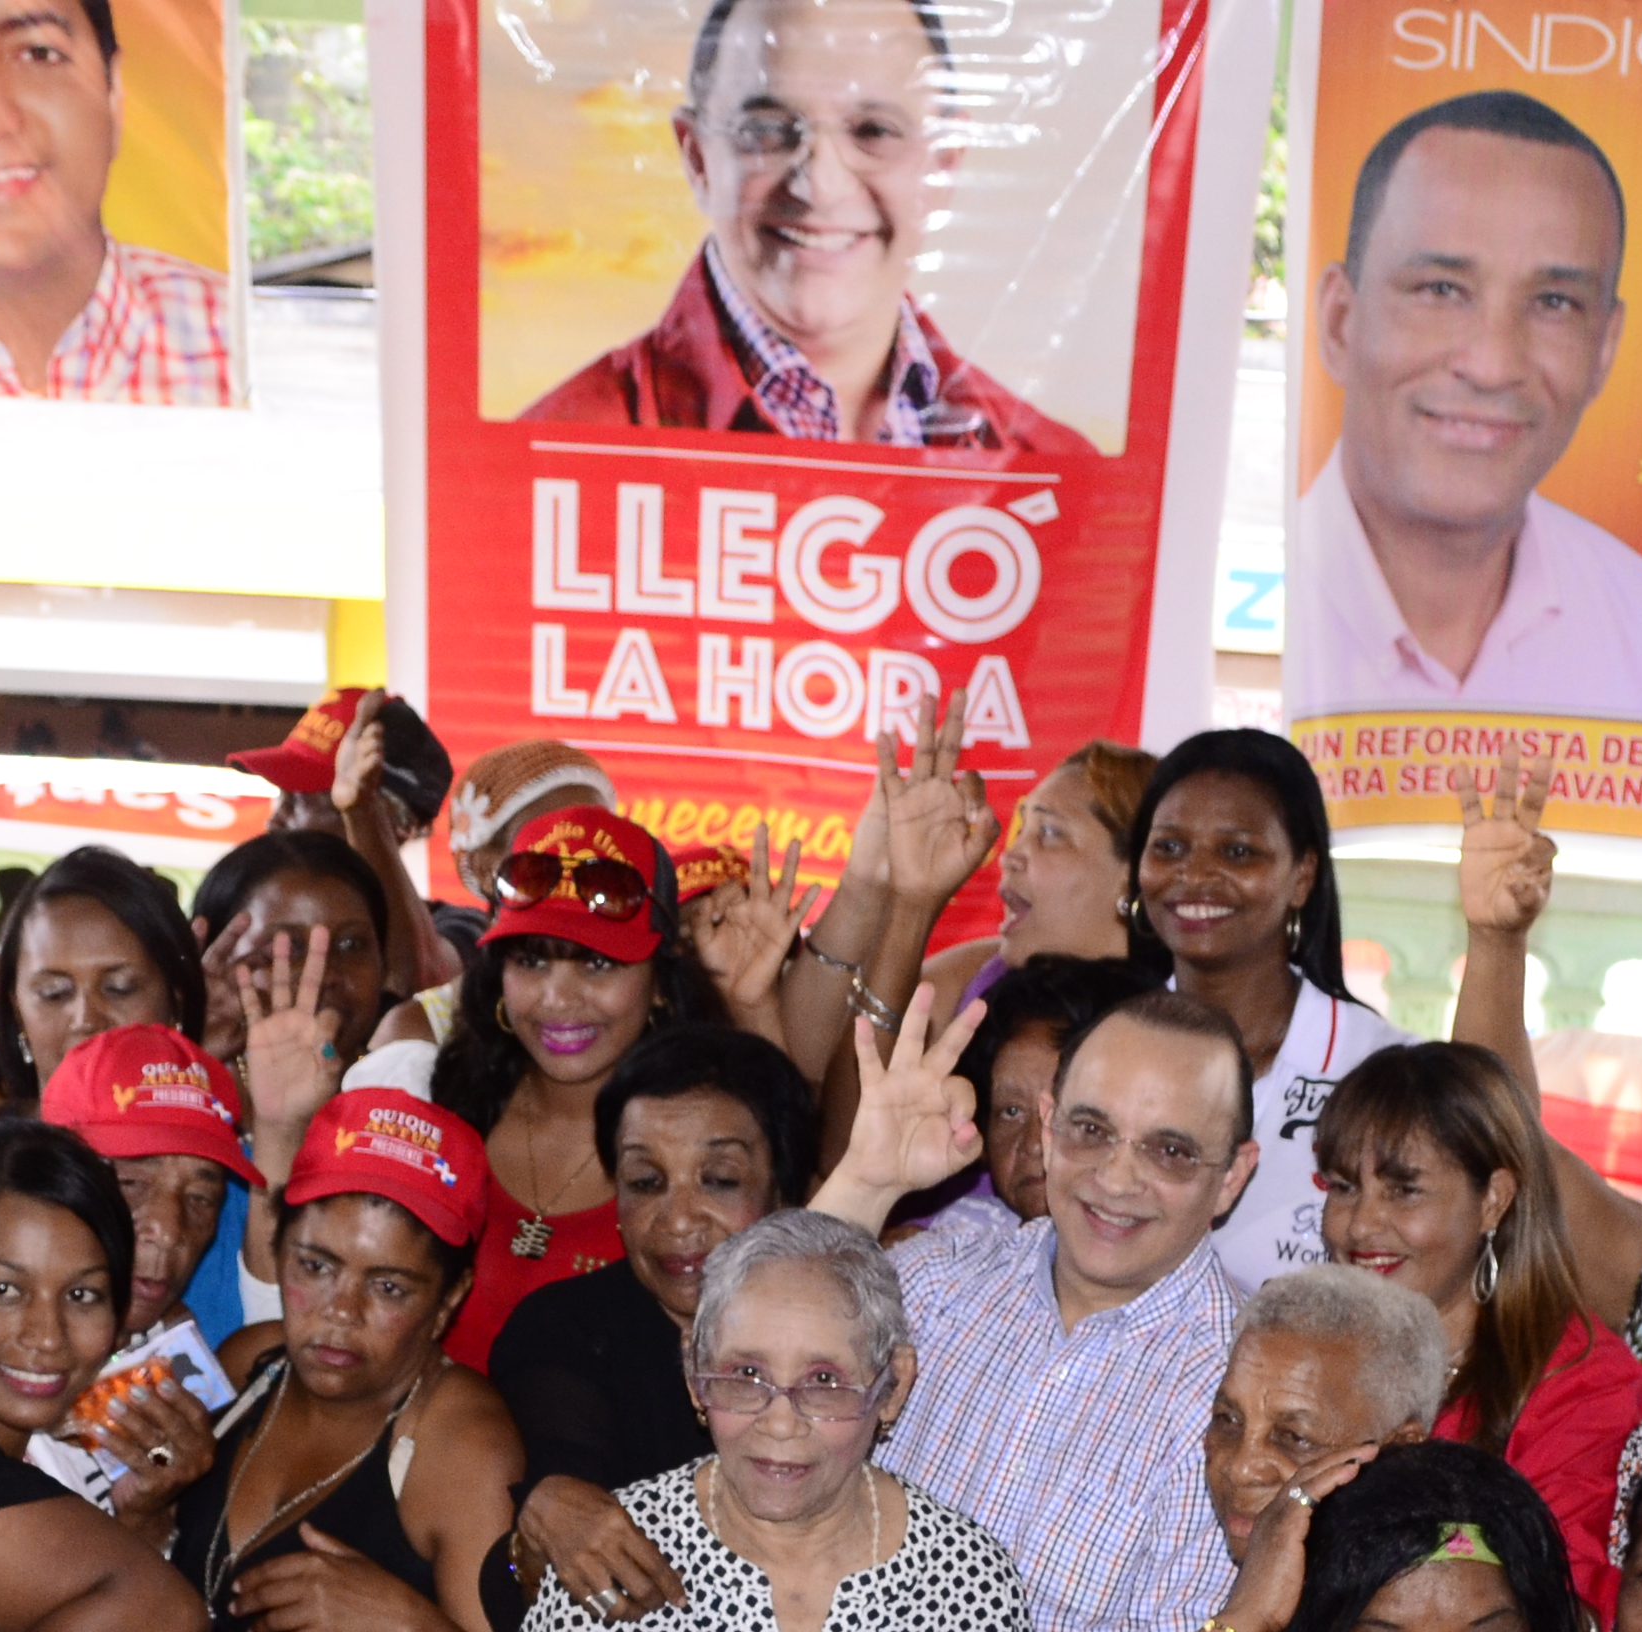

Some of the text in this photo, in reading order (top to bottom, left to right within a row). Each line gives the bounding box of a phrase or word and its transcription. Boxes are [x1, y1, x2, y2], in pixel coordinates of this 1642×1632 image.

[531, 477, 1060, 645] LLEGÓ
[530, 622, 1033, 750] LA HORA
[1300, 728, 1343, 762] UN
[369, 1107, 443, 1143] QUIQUE
